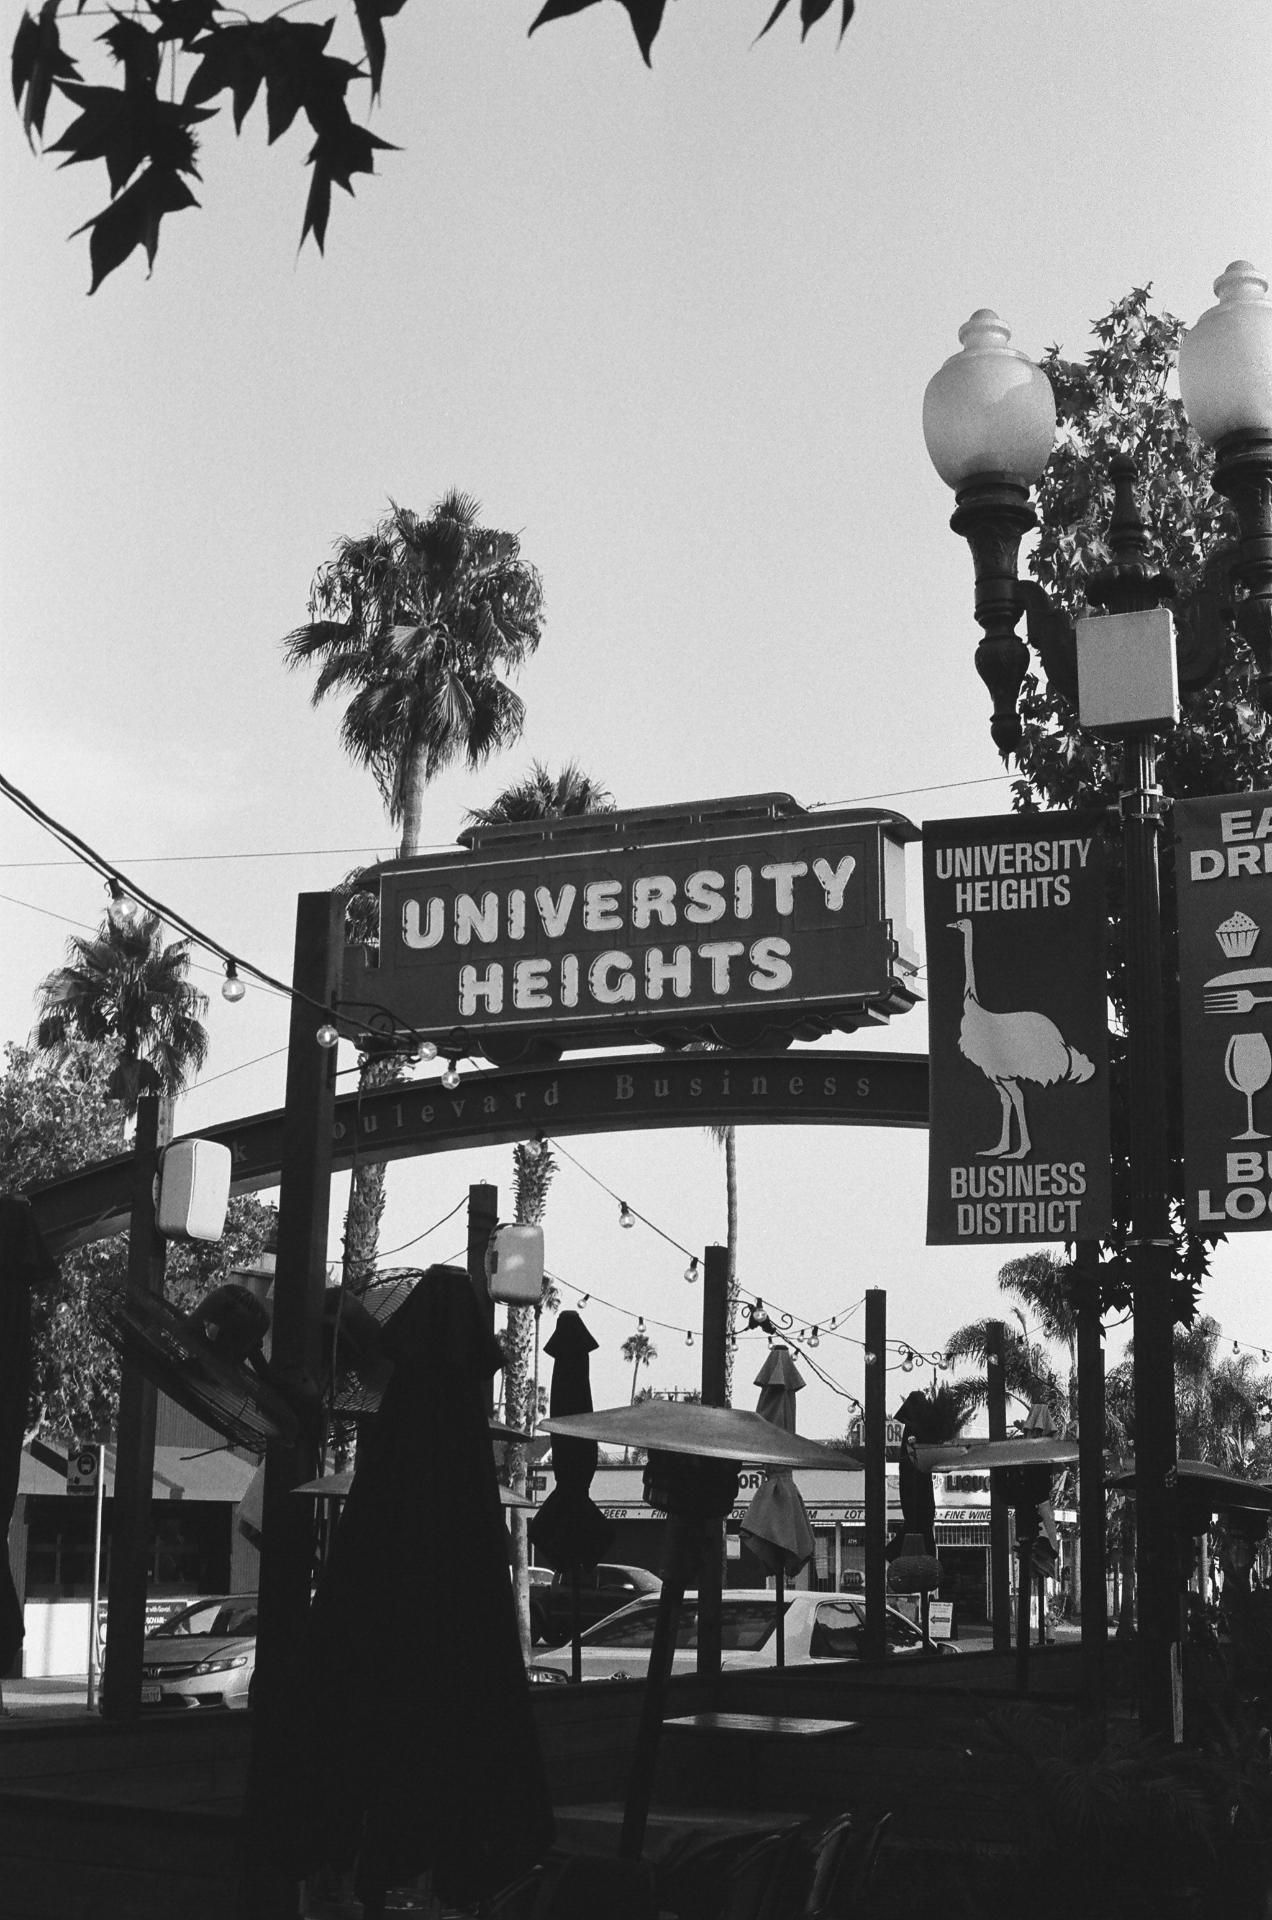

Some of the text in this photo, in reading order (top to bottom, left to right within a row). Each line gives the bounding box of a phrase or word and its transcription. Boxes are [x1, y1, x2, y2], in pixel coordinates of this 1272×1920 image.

[936, 838, 1092, 880] UNIVERSITY
[402, 854, 857, 950] UNIVERSITY
[955, 874, 1071, 913] HEIGHTS
[458, 936, 794, 1017] HEIGHTS
[333, 1067, 871, 1141] oulevard Business
[950, 1162, 1087, 1199] BUSINESS
[957, 1200, 1082, 1236] DISTRICT
[946, 1475, 990, 1492] LIQUO
[944, 1510, 966, 1519] FINE
